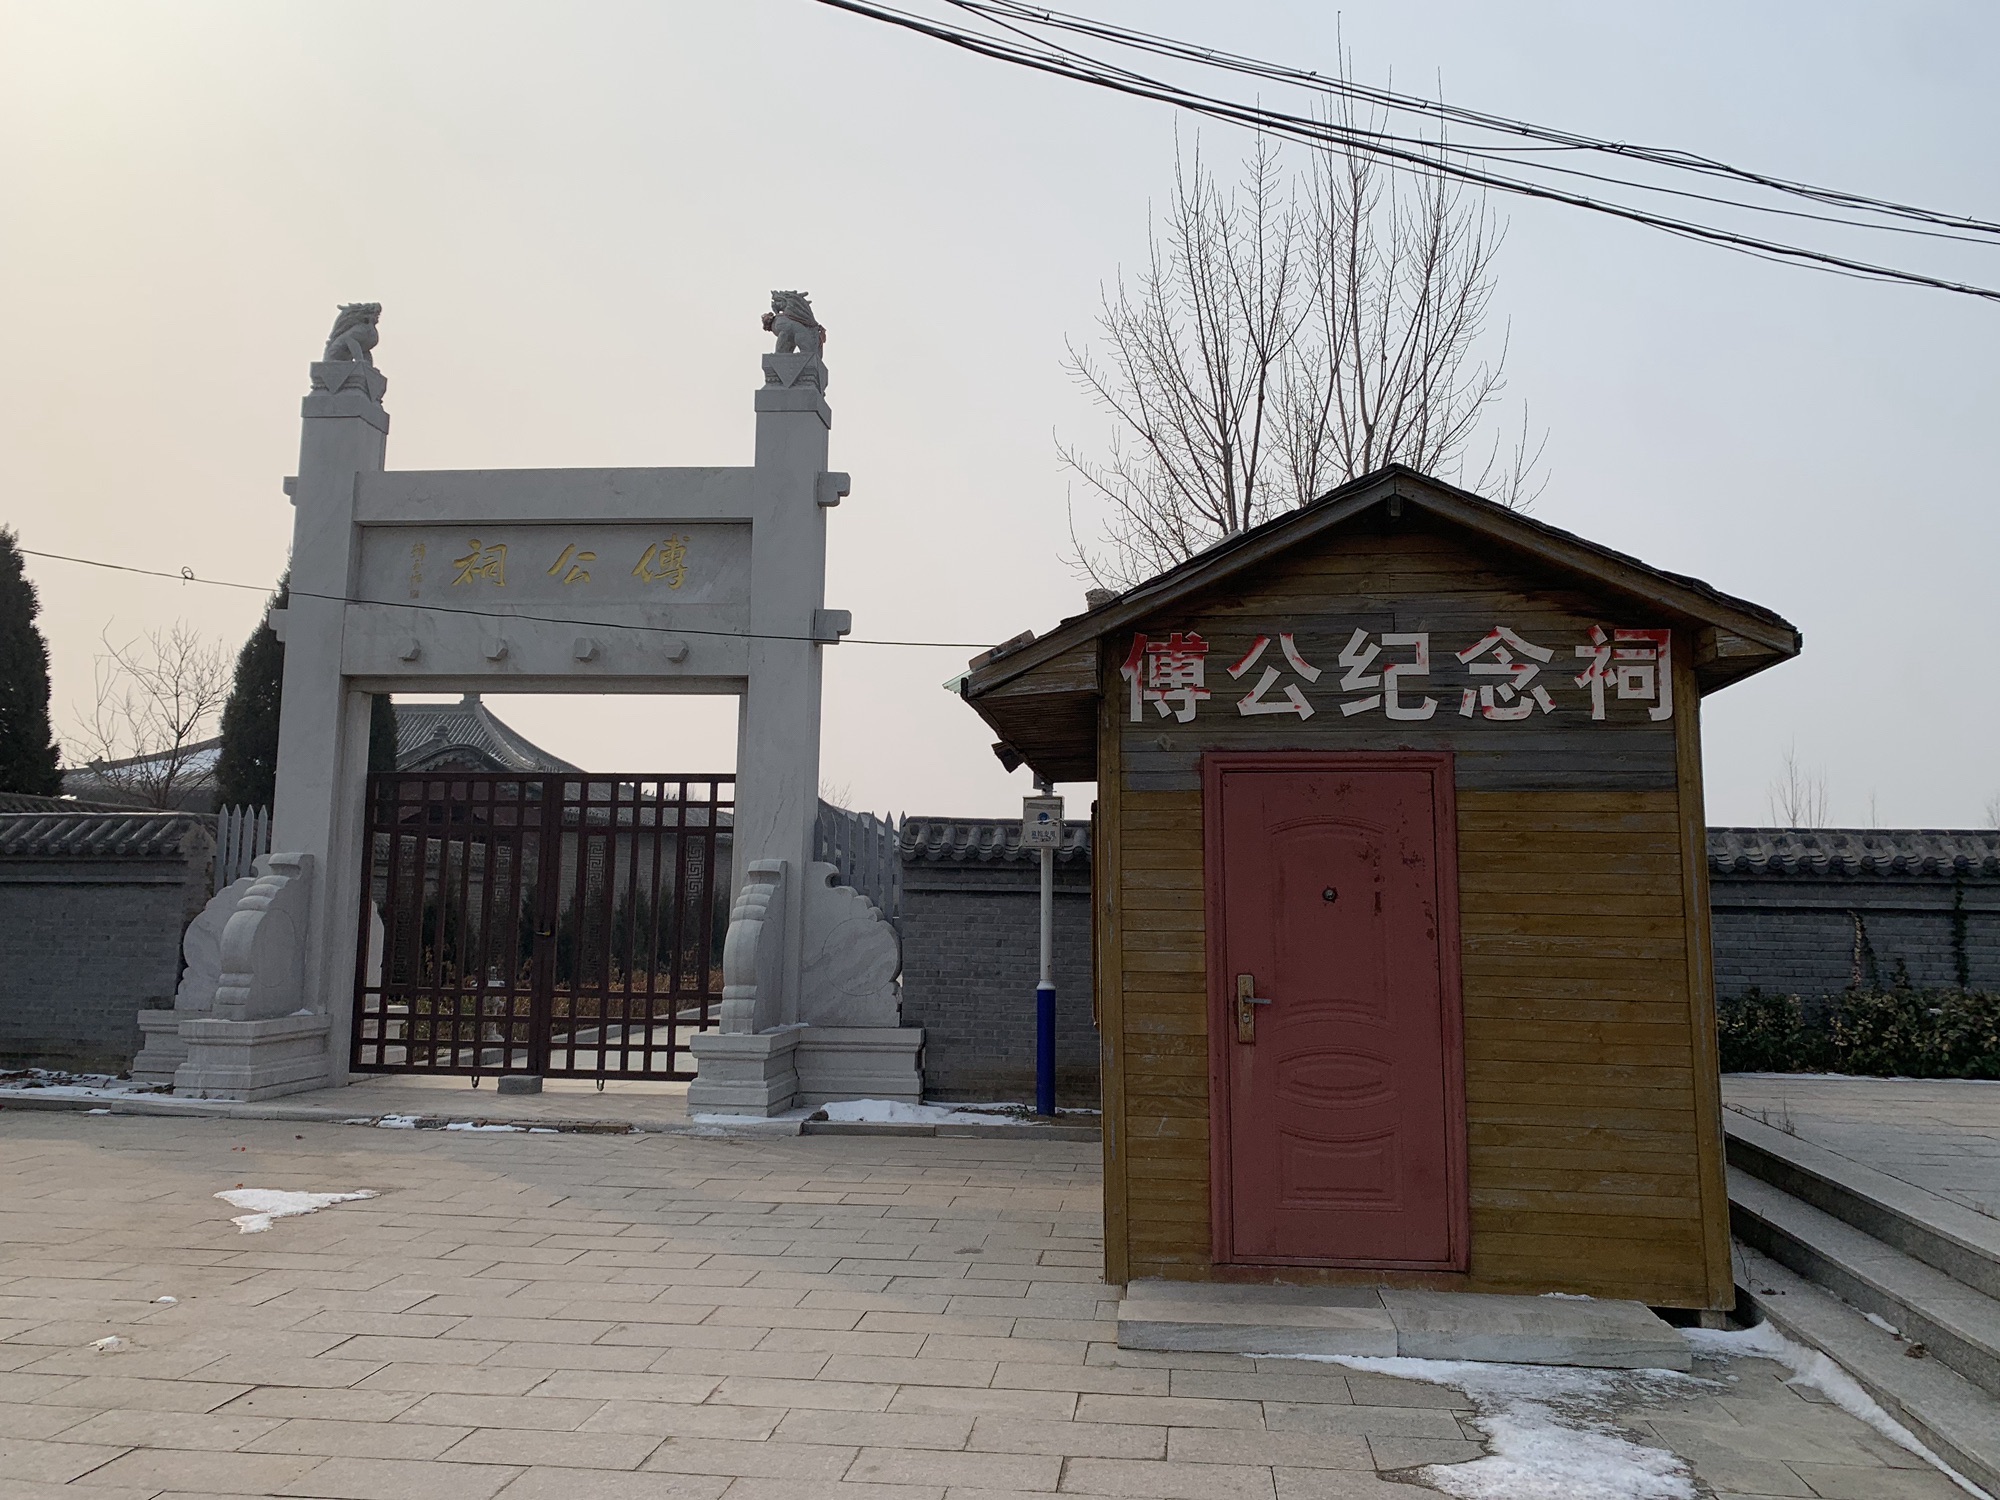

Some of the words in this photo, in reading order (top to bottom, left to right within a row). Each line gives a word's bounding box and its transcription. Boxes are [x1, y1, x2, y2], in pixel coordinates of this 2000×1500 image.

[1120, 624, 1672, 722] 傅公纪念祠
